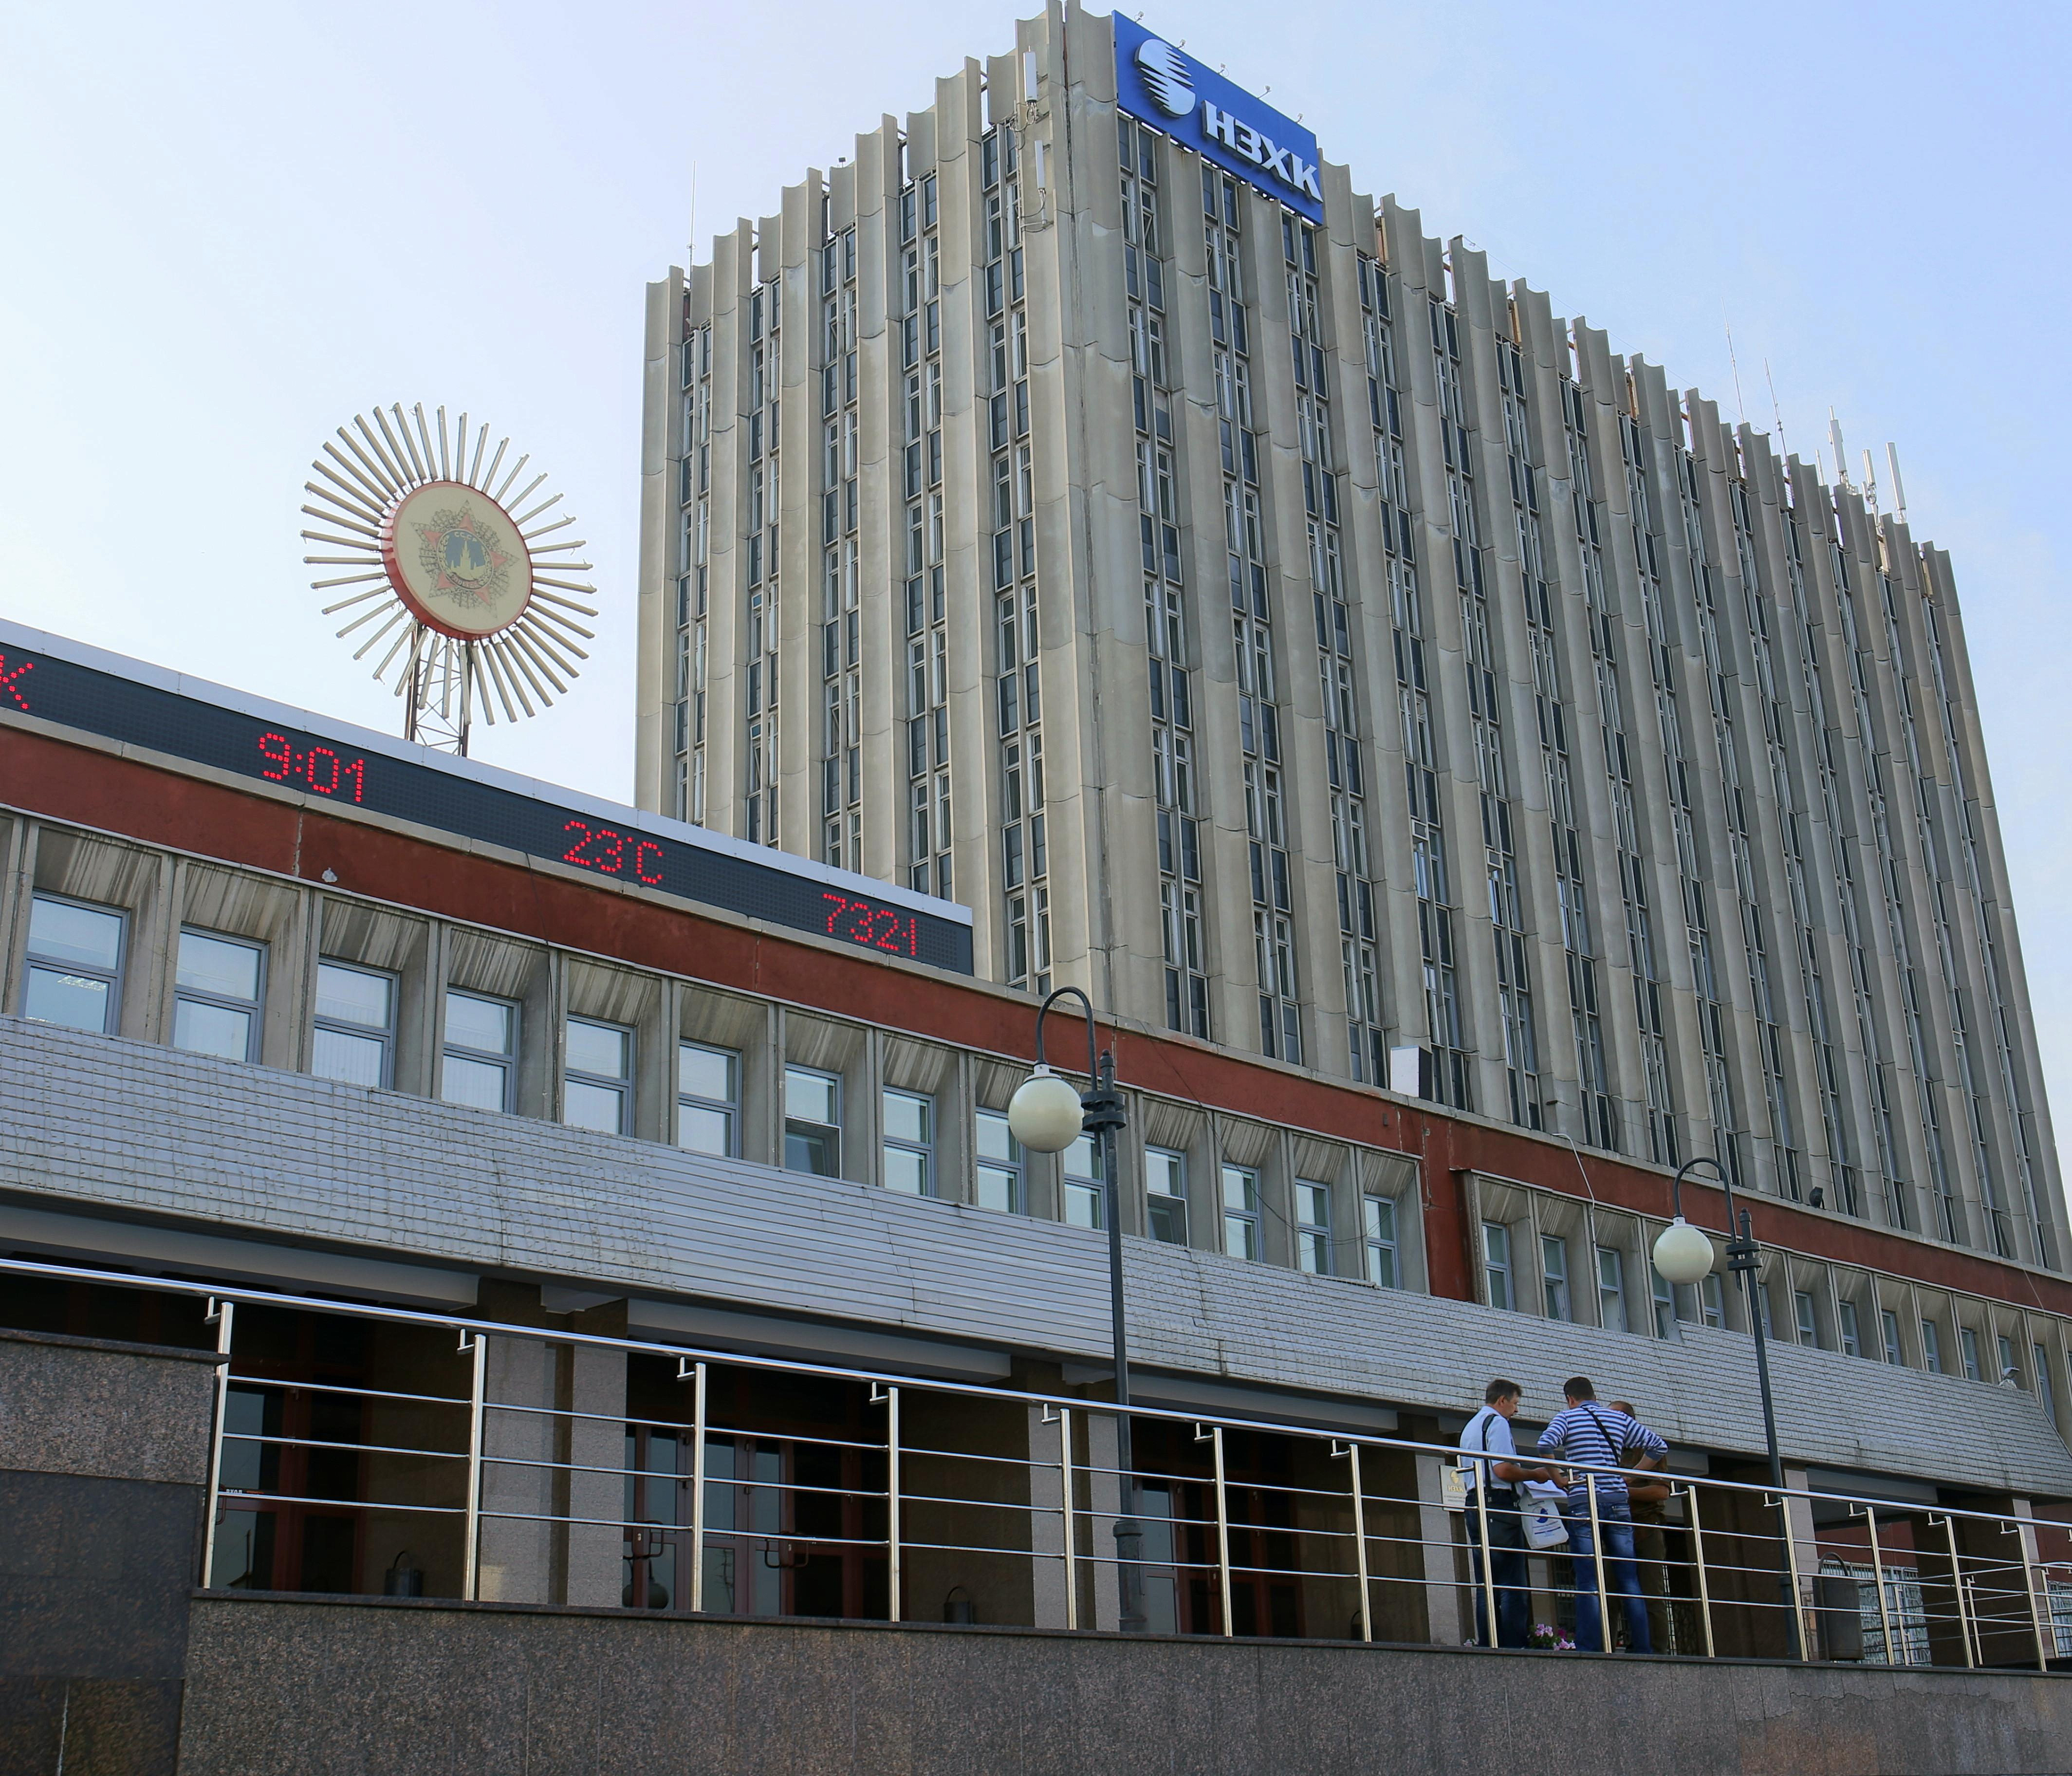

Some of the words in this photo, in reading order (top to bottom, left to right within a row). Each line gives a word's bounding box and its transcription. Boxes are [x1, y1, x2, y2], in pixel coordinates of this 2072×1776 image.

[1201, 99, 1323, 204] НЗХК
[259, 732, 364, 802] 9:01
[823, 893, 916, 955] 7321
